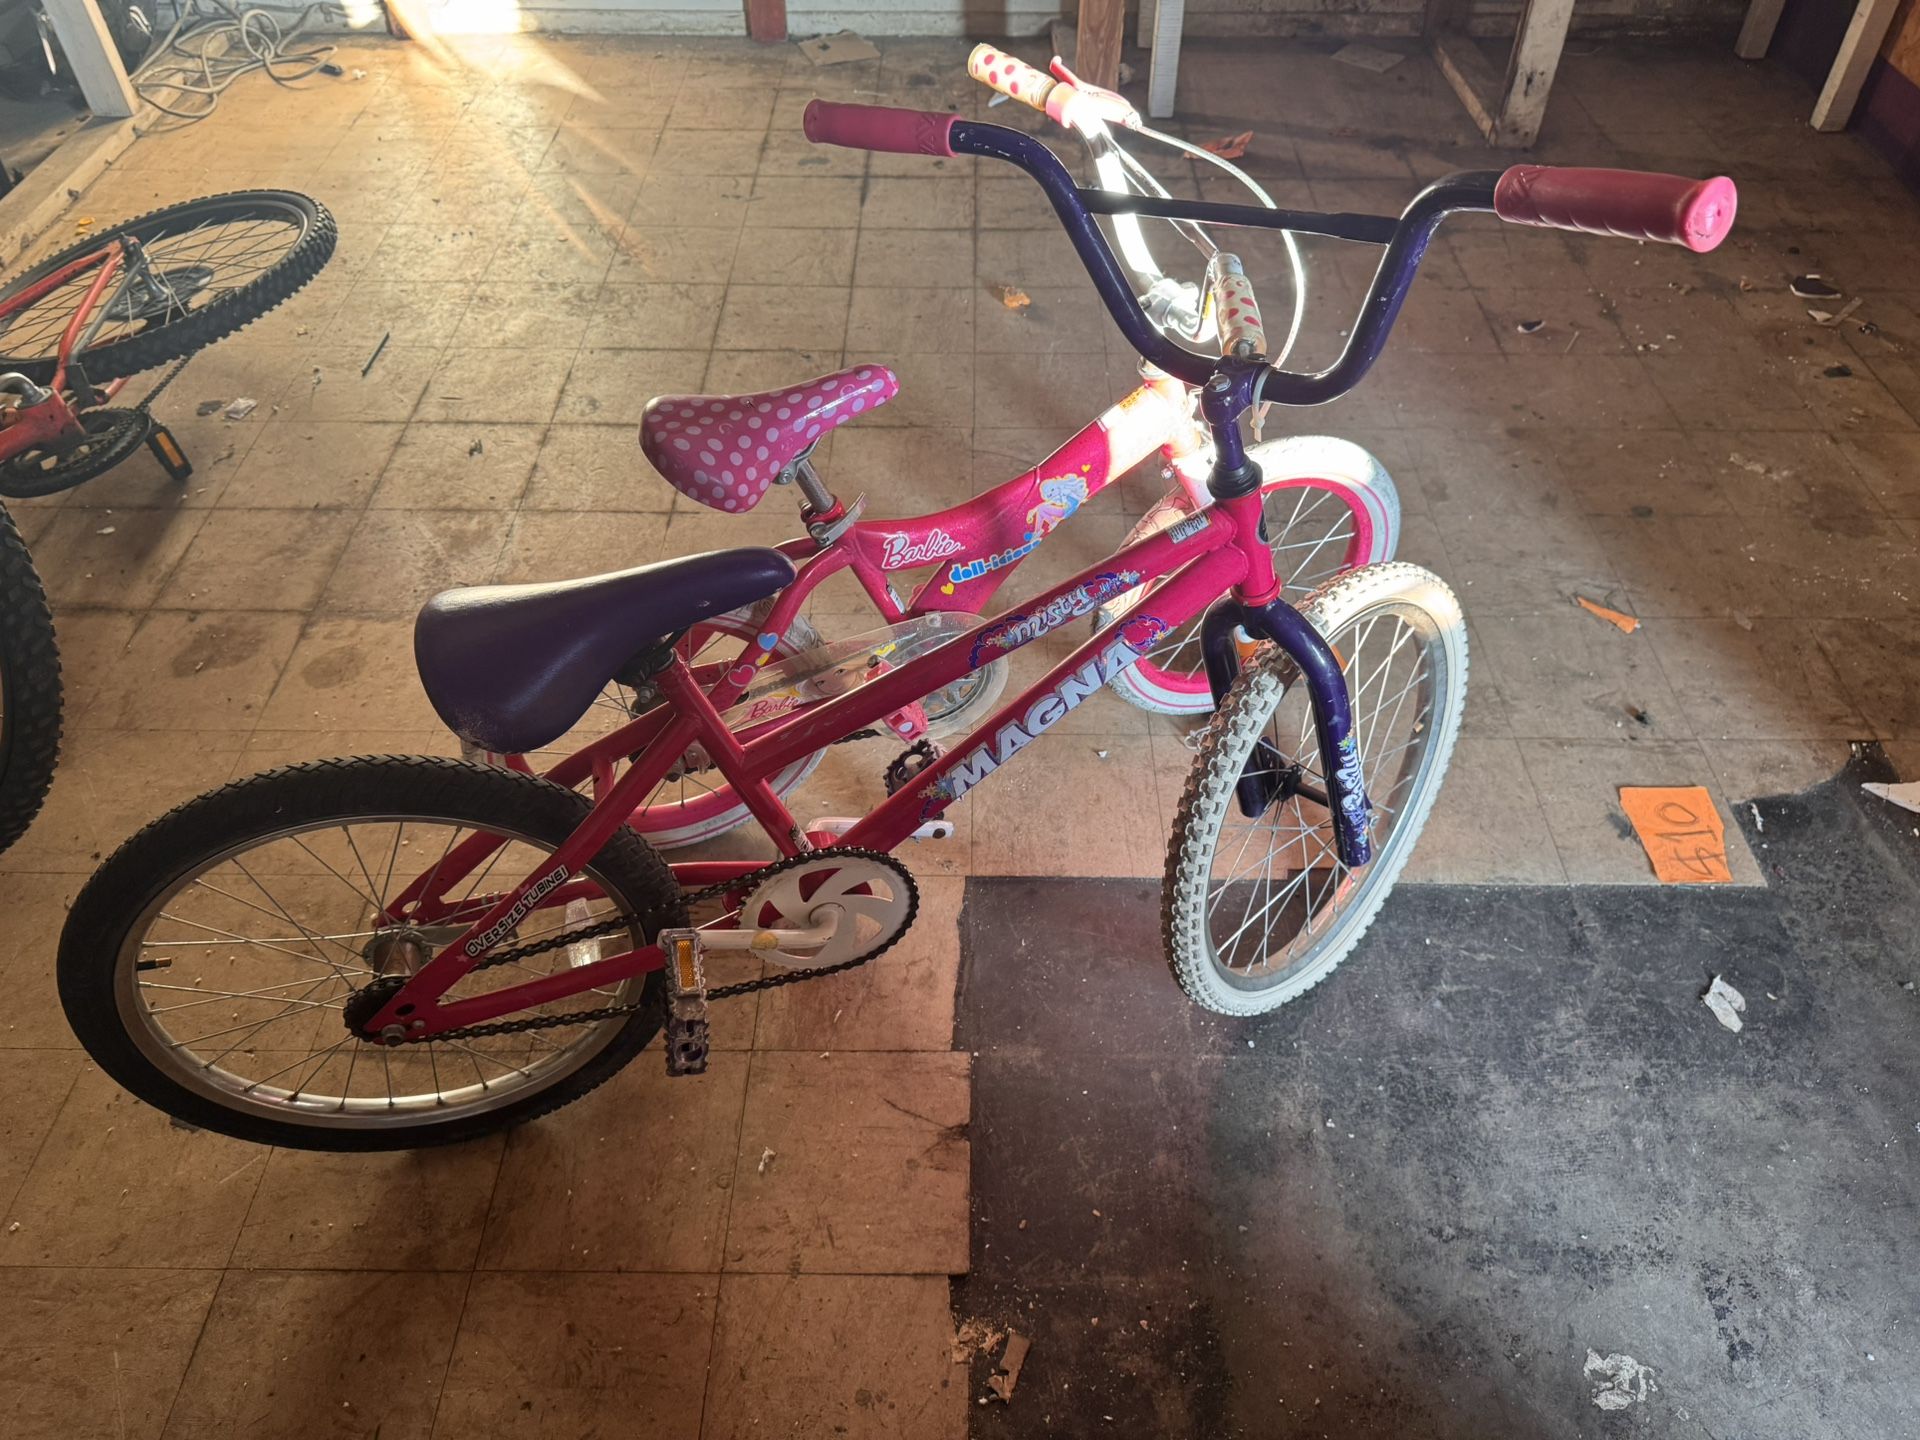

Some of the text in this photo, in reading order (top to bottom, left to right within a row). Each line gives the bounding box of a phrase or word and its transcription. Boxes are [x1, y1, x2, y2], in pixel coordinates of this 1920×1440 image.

[881, 528, 961, 569] Barbie
[1013, 582, 1099, 641] misty
[750, 696, 801, 719] Barbie
[947, 635, 1142, 800] MAGNA
